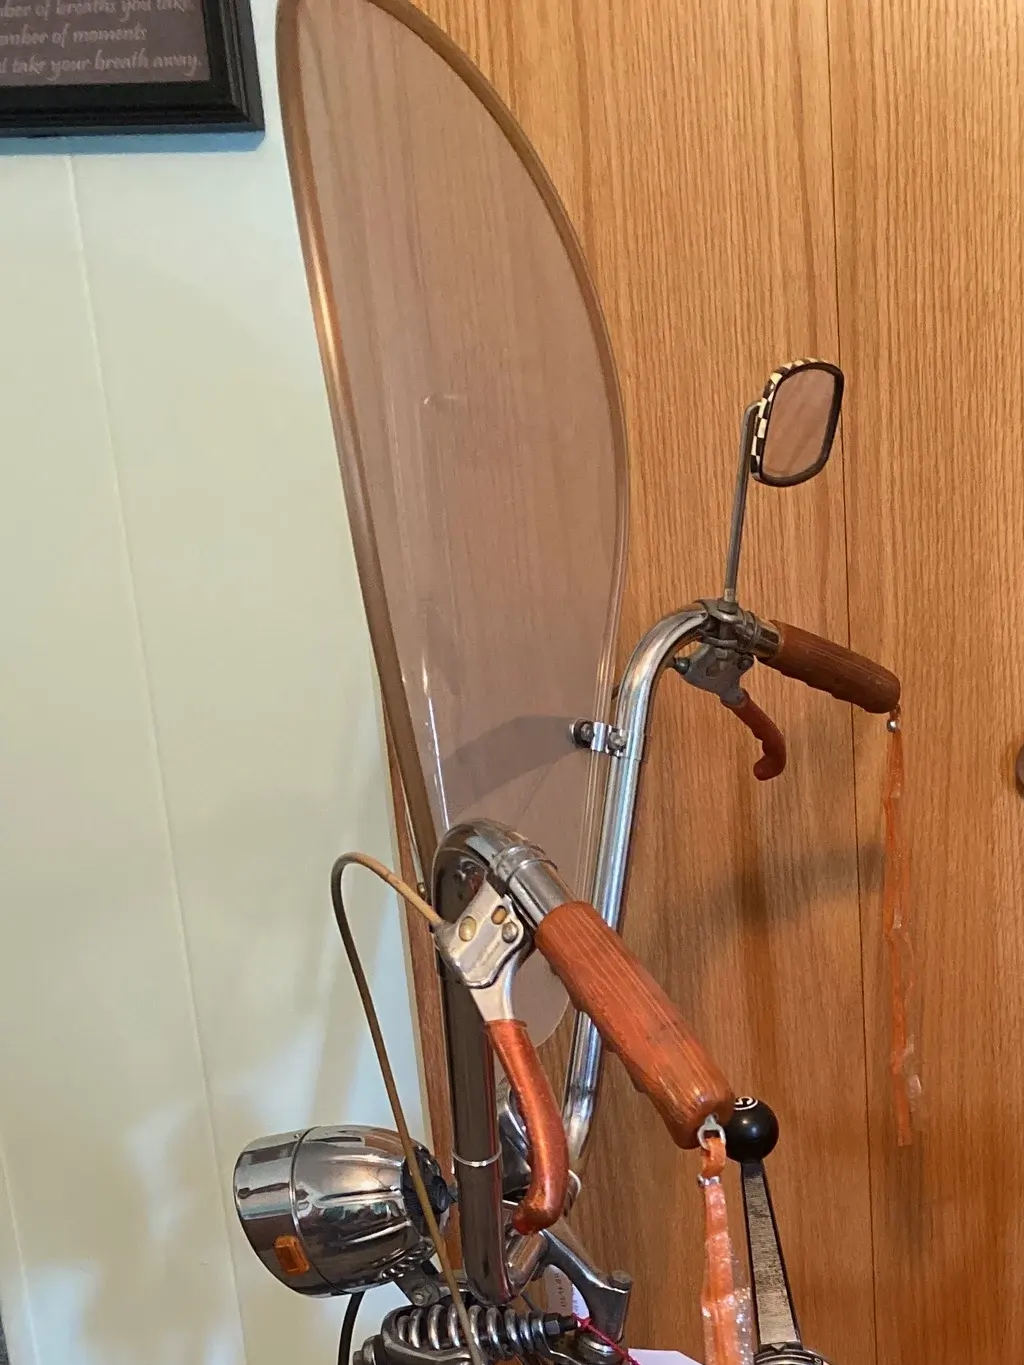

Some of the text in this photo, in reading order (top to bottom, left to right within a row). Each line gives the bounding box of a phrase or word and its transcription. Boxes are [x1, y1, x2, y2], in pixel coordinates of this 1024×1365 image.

[36, 0, 52, 20] of
[119, 0, 151, 22] you
[52, 23, 69, 48] of
[73, 22, 147, 43] moments
[12, 52, 47, 74] take
[46, 59, 92, 81] your
[95, 48, 149, 71] breath
[153, 54, 202, 77] away.
